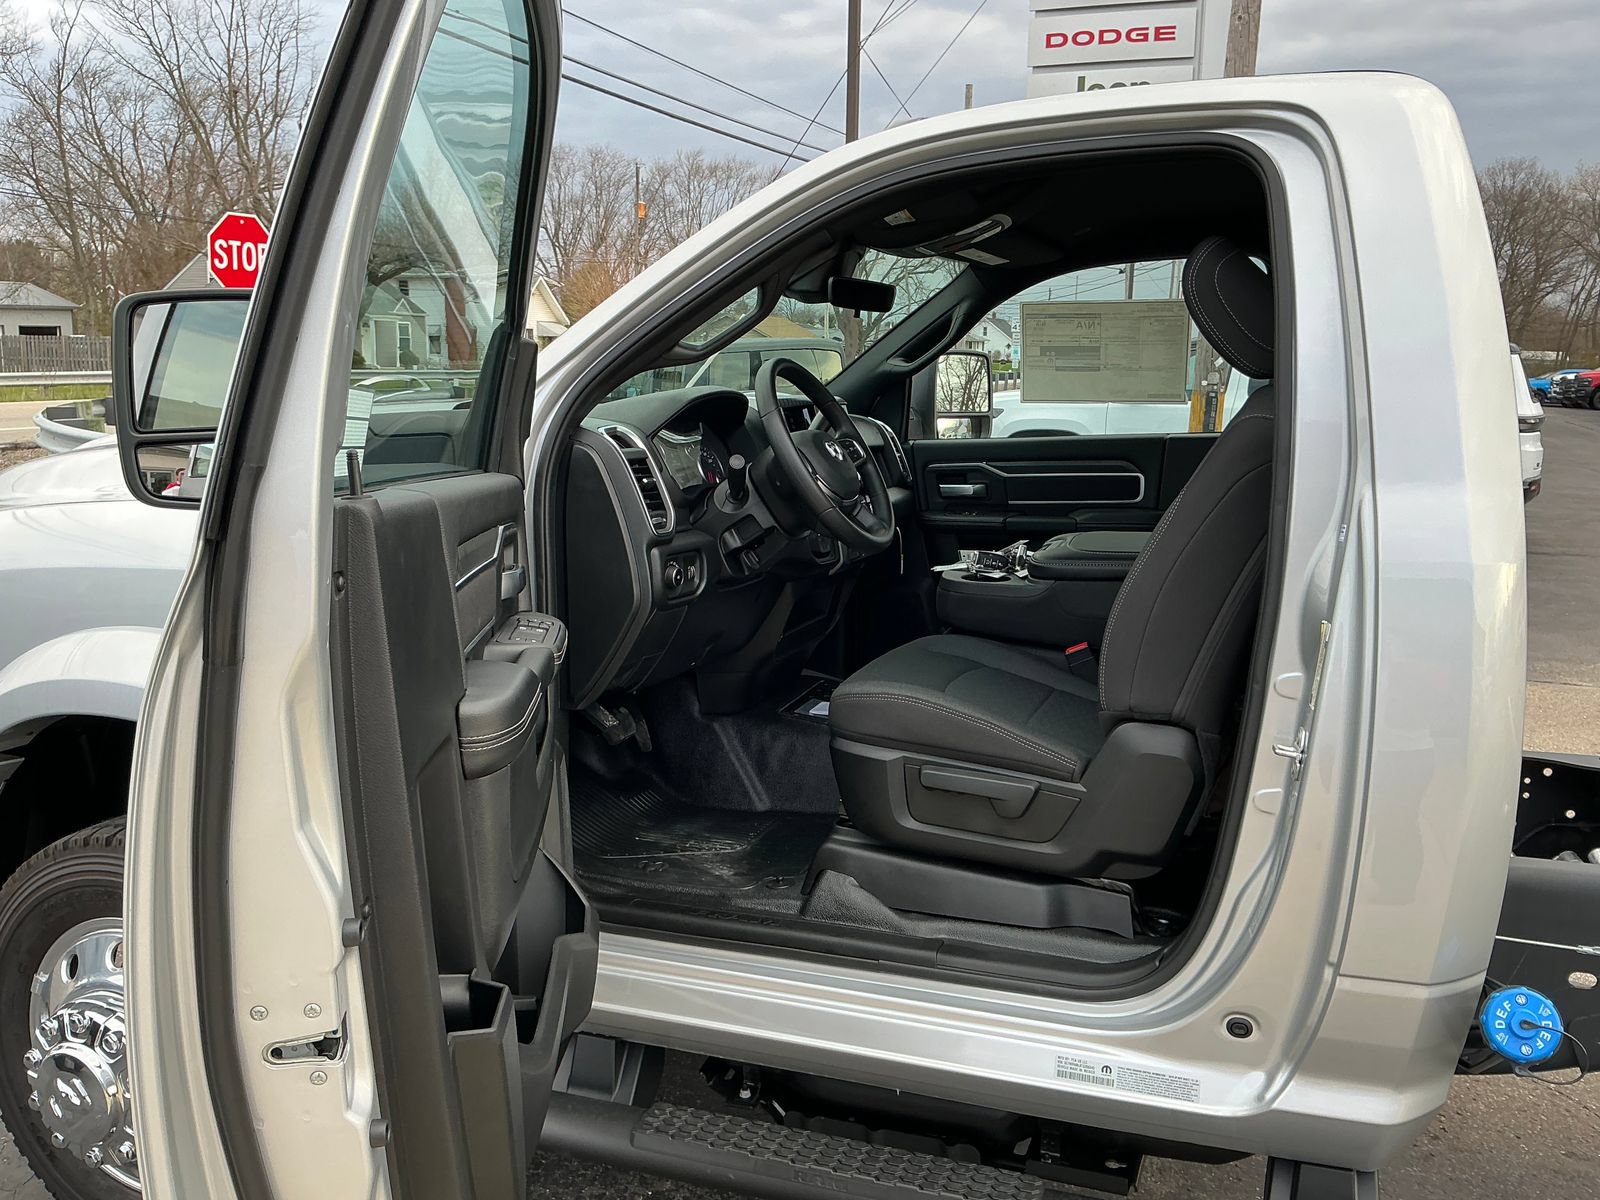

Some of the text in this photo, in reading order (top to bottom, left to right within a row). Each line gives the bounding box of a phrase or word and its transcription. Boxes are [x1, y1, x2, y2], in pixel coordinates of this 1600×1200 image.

[1044, 25, 1177, 49] DODGE
[1495, 1000, 1513, 1029] DEF
[1535, 1020, 1553, 1050] DEF
